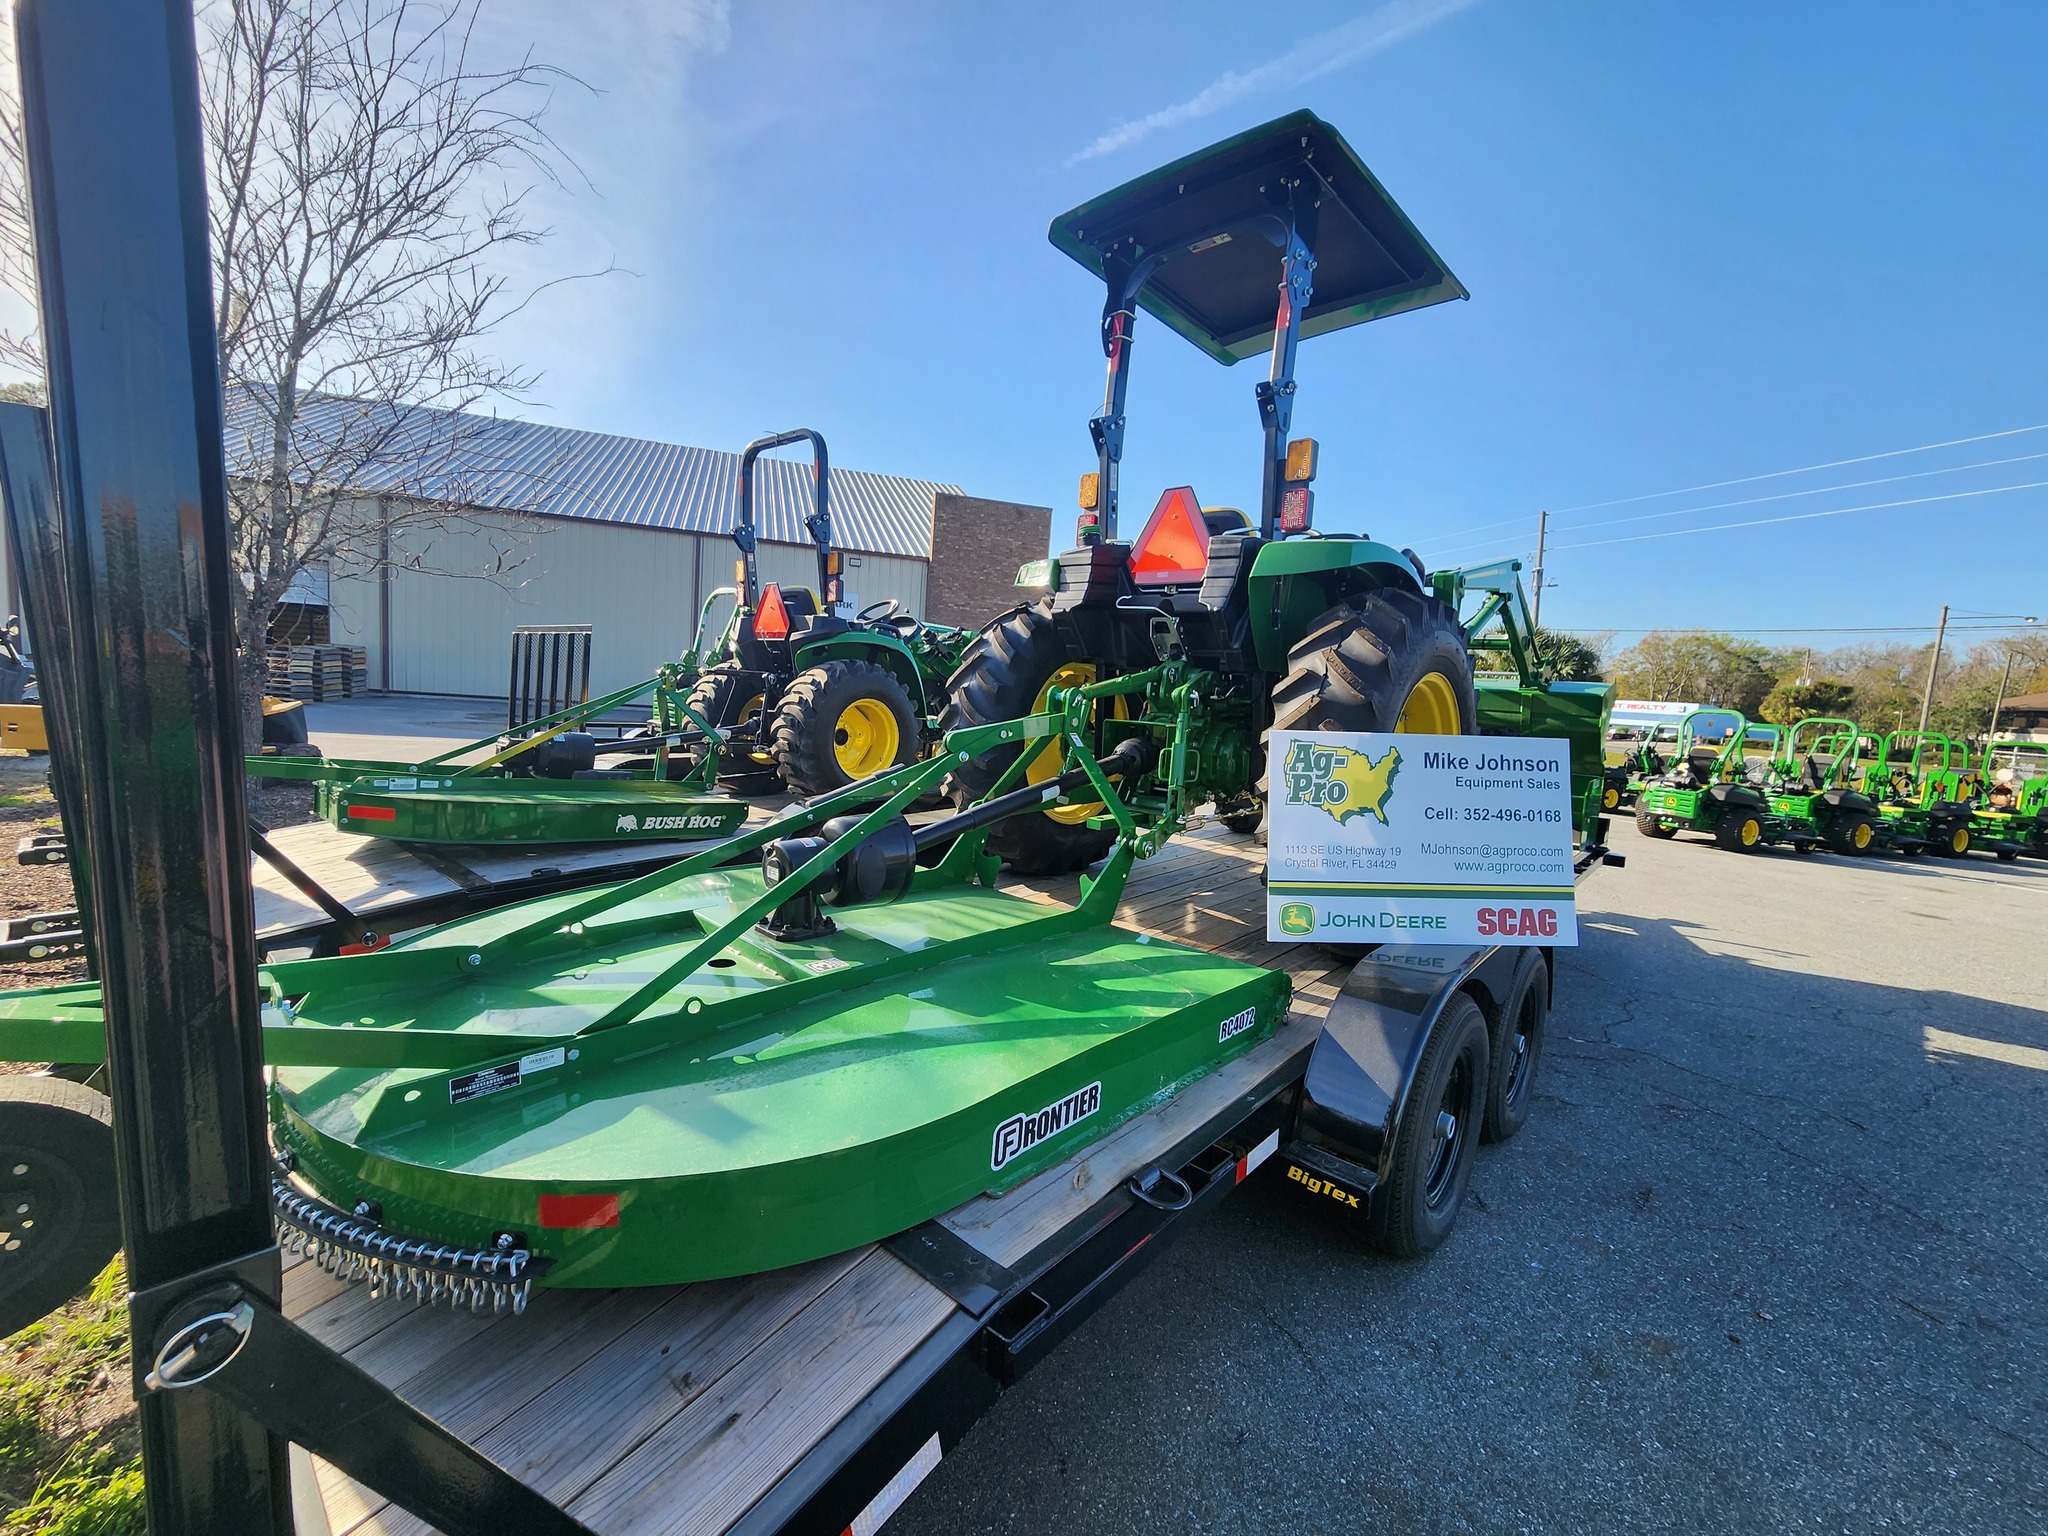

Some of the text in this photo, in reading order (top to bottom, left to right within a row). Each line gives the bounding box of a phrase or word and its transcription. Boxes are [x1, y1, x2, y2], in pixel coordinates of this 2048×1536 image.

[1289, 741, 1348, 779] Ag-
[1424, 752, 1560, 772] Mike Johnson
[1286, 774, 1348, 805] Pro
[1456, 776, 1561, 790] Equipment Sales
[642, 816, 687, 830] BUSH
[1424, 807, 1562, 822] Cell: 352-496-0168
[1286, 845, 1402, 857] 1113 SE US Highway 19
[1421, 843, 1564, 858] MJohnson@agproco.com
[1285, 858, 1397, 870] Crystal River, FL 34429
[1454, 861, 1565, 874] www.agproco.com
[1320, 911, 1447, 929] JOHN DEERE
[1476, 907, 1558, 937] SCAG
[1220, 1008, 1255, 1039] RC4072
[994, 1083, 1100, 1168] FRONTIER
[1287, 1165, 1361, 1209] BigTex
